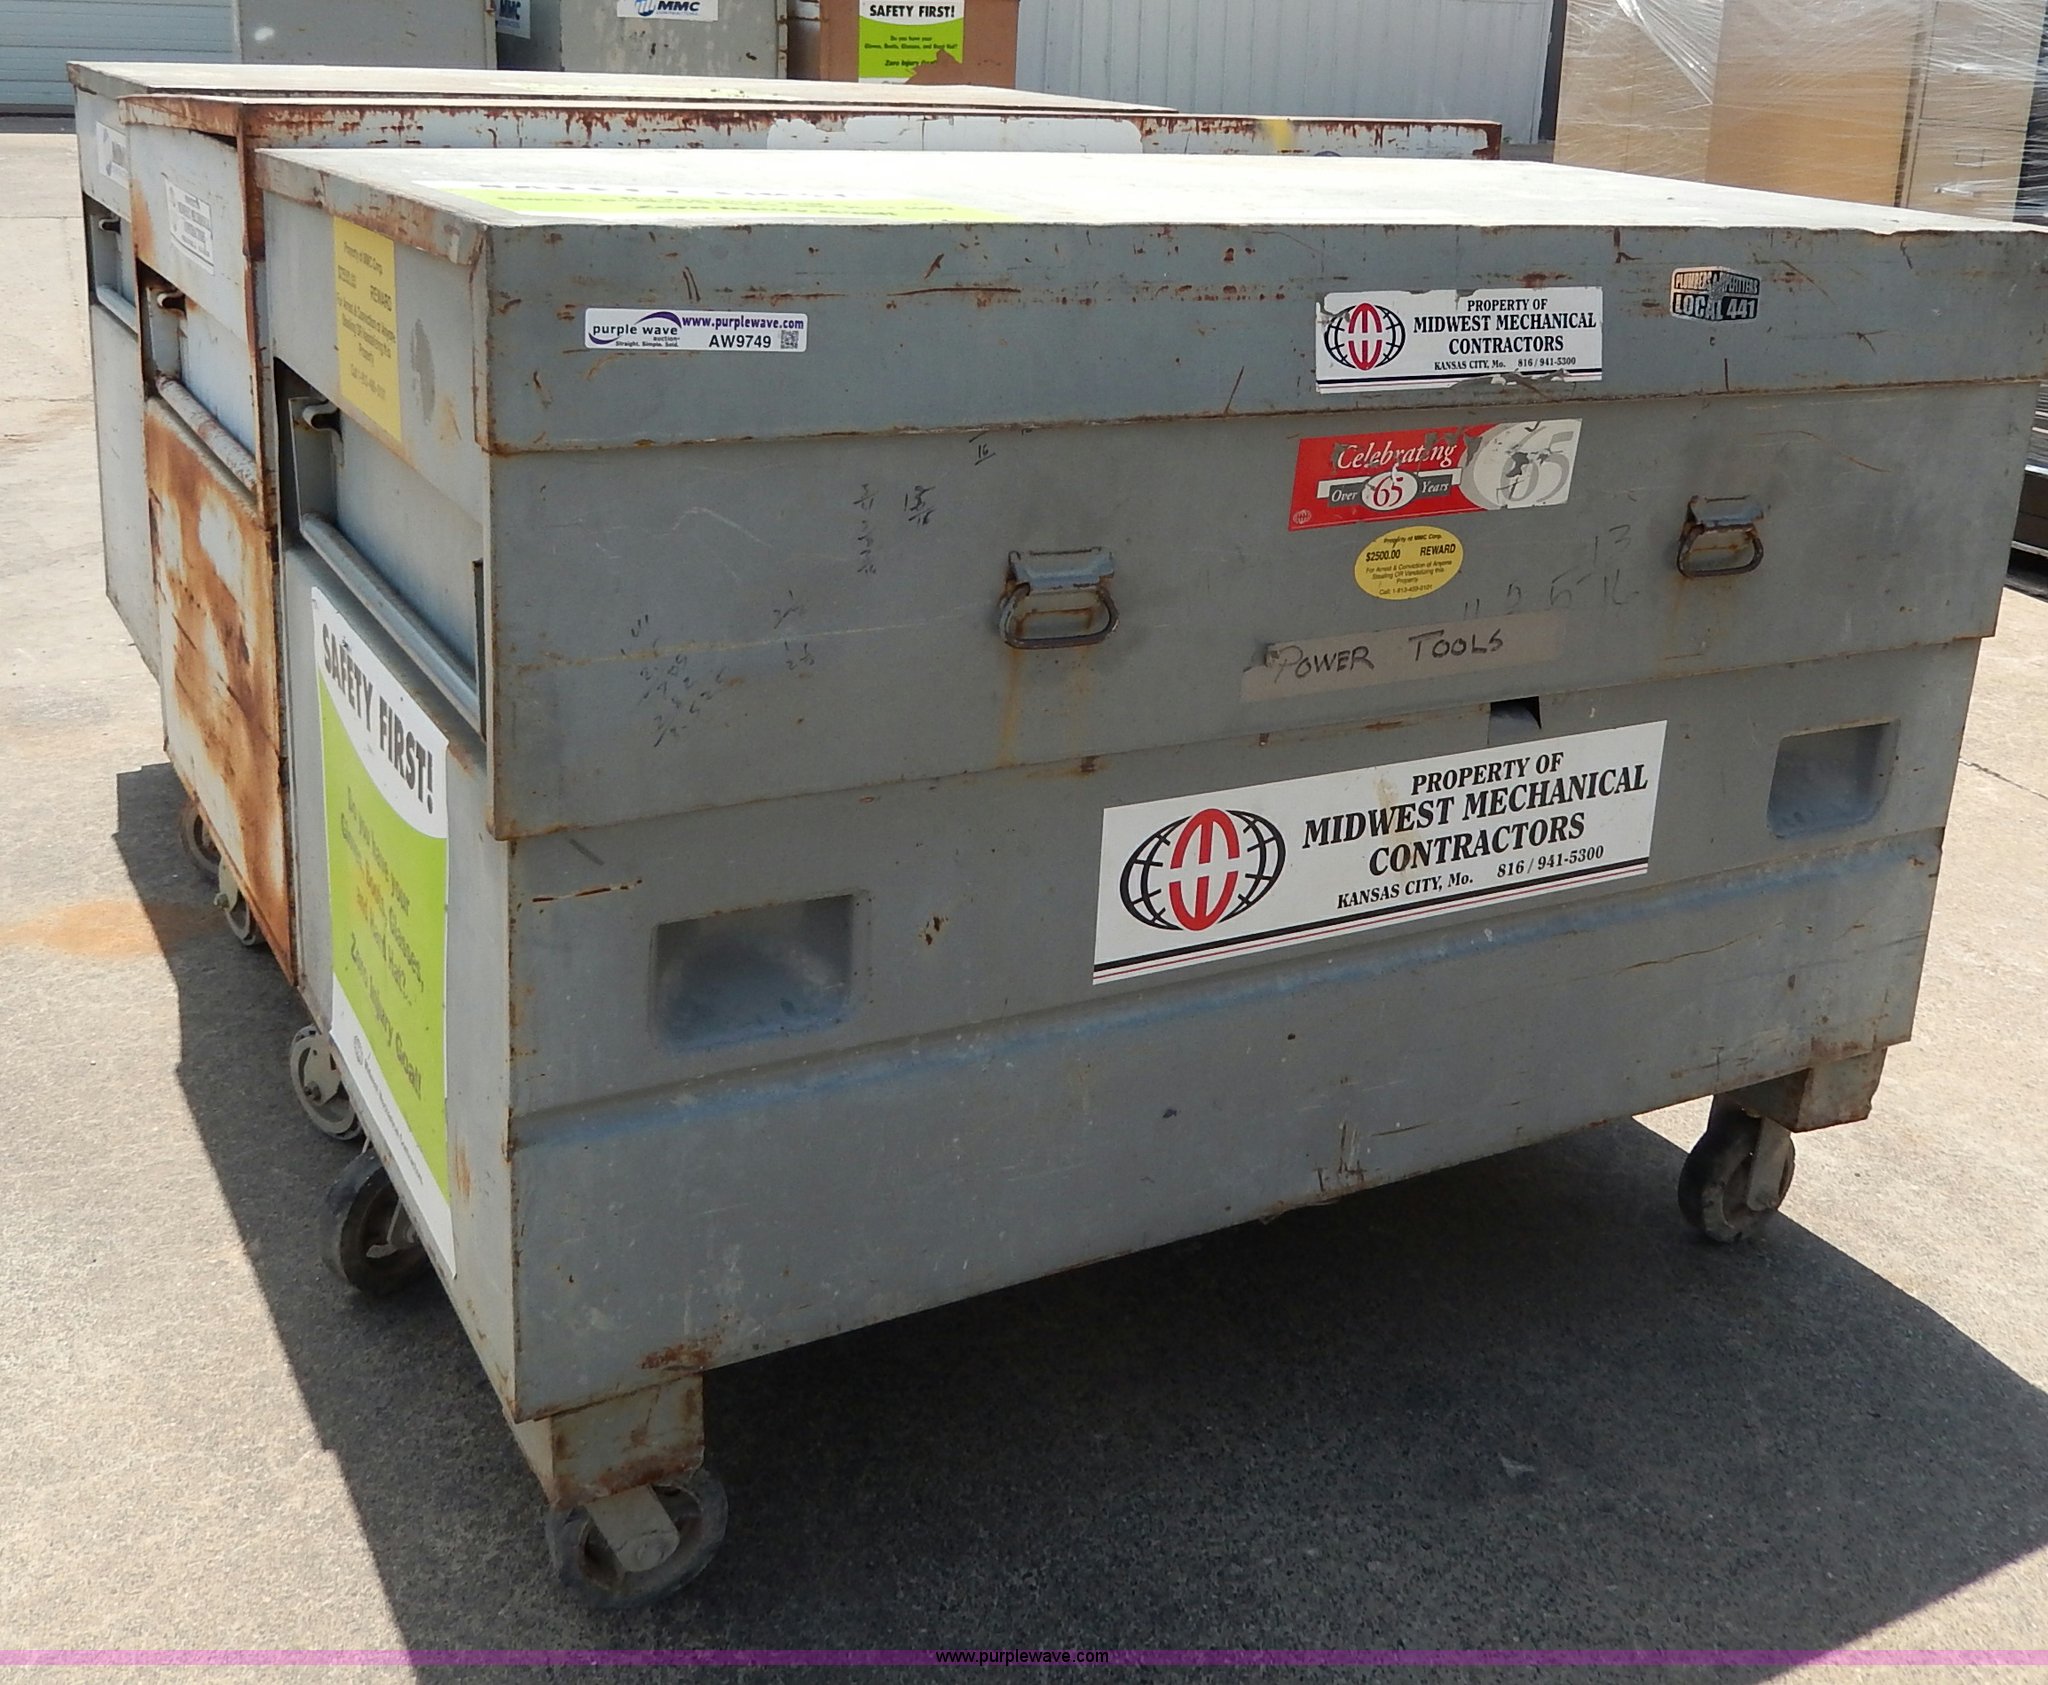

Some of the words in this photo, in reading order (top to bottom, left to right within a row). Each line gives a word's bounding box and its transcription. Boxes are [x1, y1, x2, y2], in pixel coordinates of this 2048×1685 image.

[658, 1, 700, 11] MMC
[870, 5, 914, 17] SAFETY
[919, 6, 955, 18] FIRST!
[1467, 299, 1528, 312] PROPERTY
[1532, 298, 1548, 310] OF
[1674, 294, 1724, 320] LOCAL
[1726, 298, 1755, 319] 441
[592, 324, 638, 336] purple
[642, 326, 678, 335] wave
[682, 315, 804, 331] www.purplewave.com
[1413, 314, 1491, 334] MIDWEST
[1496, 312, 1597, 331] MECHANICAL
[708, 335, 772, 348] AW9749
[1449, 335, 1564, 355] CONTRACTORS
[1434, 360, 1467, 371] KANSAS
[1469, 359, 1490, 370] CITY,
[1337, 440, 1457, 468] Celebratng
[1332, 489, 1358, 502] Over
[1373, 476, 1404, 506] 65
[1421, 481, 1449, 494] Years
[1366, 549, 1400, 562] $2500.00
[1420, 544, 1456, 556] REWARD
[1275, 645, 1374, 683] POWER
[1409, 629, 1503, 661] TOOLS
[322, 623, 372, 732] SAFETY
[380, 696, 433, 814] FIRST!
[1410, 758, 1531, 796] PROPERTY
[1536, 752, 1564, 775] OF
[1302, 796, 1455, 849] MIDWEST
[1462, 764, 1648, 821] MECHANICAL
[1369, 812, 1585, 876] CONTRACTORS
[1337, 884, 1400, 909] KANSAS
[1405, 875, 1444, 896] CITY,
